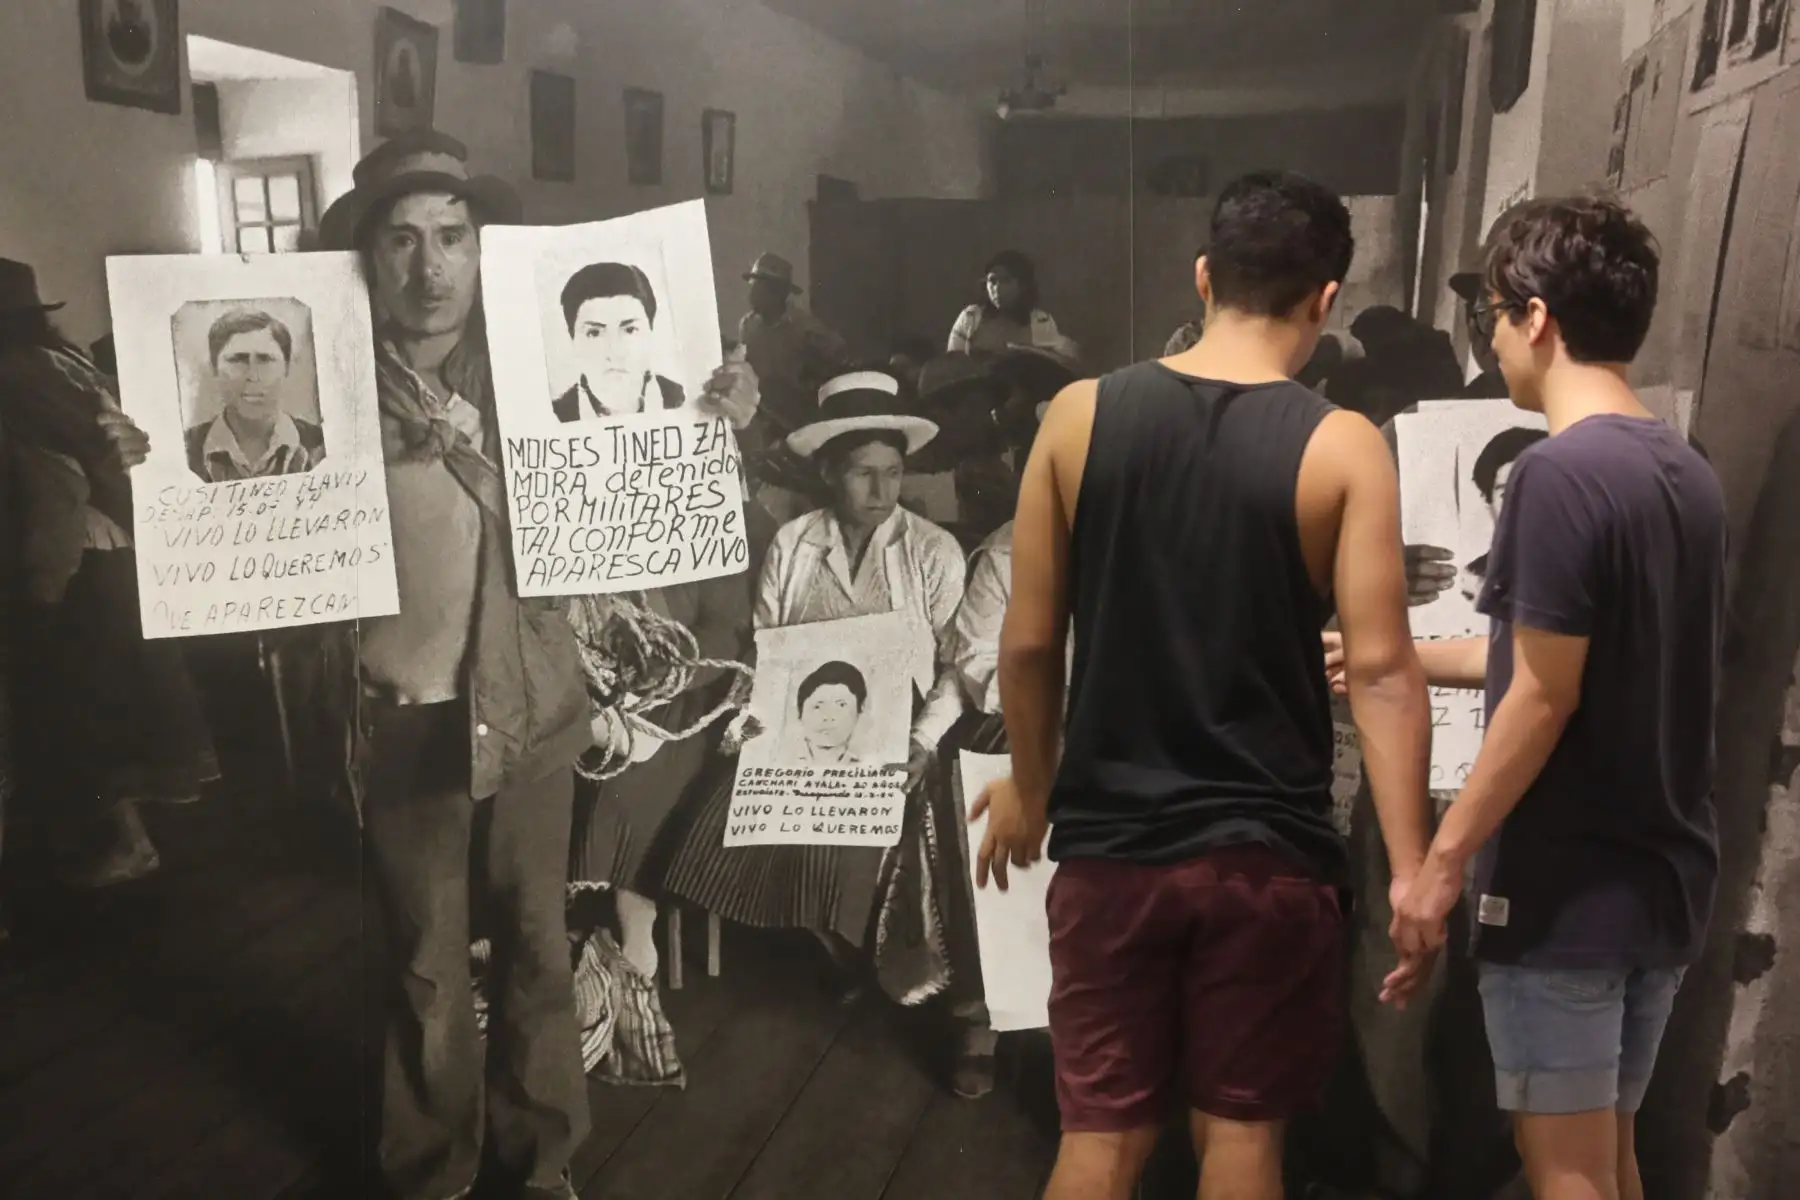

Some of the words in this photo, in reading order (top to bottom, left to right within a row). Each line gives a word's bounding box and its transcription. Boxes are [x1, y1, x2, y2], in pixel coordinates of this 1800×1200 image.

[507, 436, 600, 470] MOISES
[692, 416, 726, 455] ZA
[513, 470, 587, 498] MORA
[516, 495, 571, 524] POR
[164, 524, 224, 548] VIVO
[233, 520, 257, 546] LO
[266, 507, 384, 542] LLEVARON
[516, 525, 560, 556] TAL
[153, 561, 216, 586] VIVO
[526, 548, 681, 587] APARESCA
[690, 536, 746, 570] VIVO
[733, 804, 773, 817] VIVO
[782, 805, 804, 816] LO
[810, 805, 892, 817] LLEVARON
[731, 823, 767, 836] VIVO
[779, 822, 802, 832] LO
